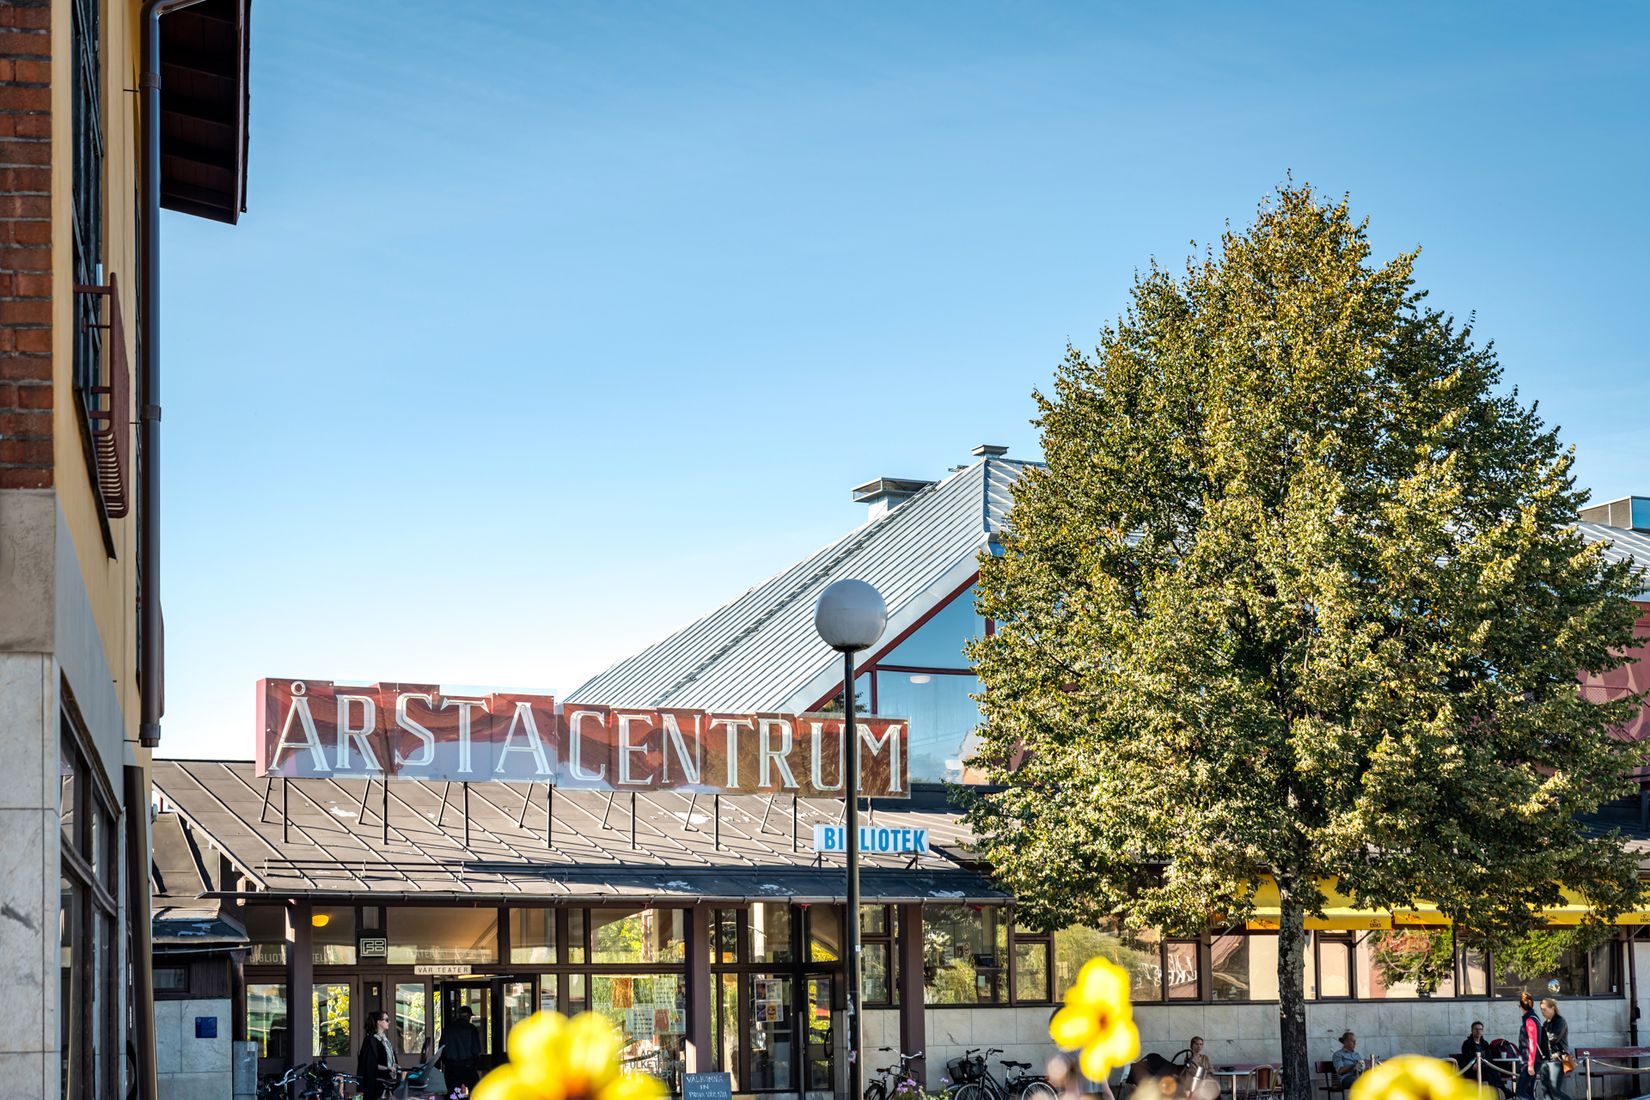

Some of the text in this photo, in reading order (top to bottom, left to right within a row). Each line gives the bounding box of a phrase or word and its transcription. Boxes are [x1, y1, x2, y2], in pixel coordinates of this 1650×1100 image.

[268, 680, 903, 793] ÅRSTA CENTRUM
[824, 827, 925, 852] BILIOTEK
